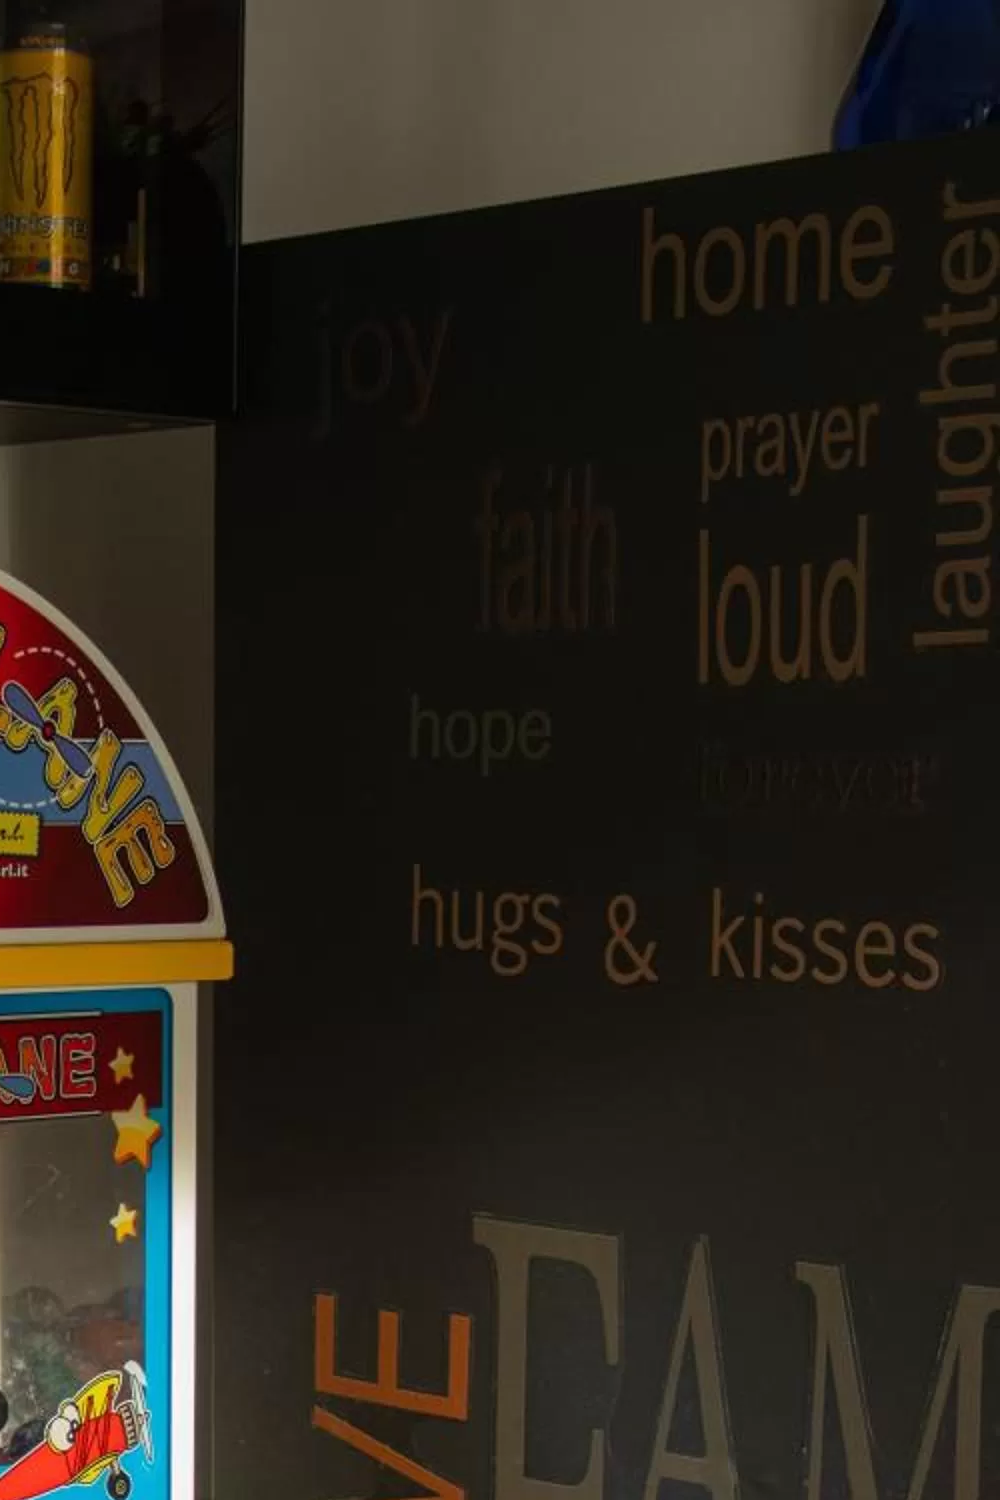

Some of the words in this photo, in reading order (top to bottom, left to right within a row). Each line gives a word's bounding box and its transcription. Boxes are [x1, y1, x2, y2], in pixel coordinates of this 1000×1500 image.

[640, 203, 895, 324] home
[308, 288, 455, 441] joy
[912, 176, 1000, 650] laughter
[702, 401, 880, 502] prayer
[474, 460, 620, 636] faith
[697, 513, 869, 687] loud
[408, 690, 553, 777] hope
[410, 862, 564, 977] hugs
[604, 892, 660, 986] &
[708, 887, 943, 991] kisses
